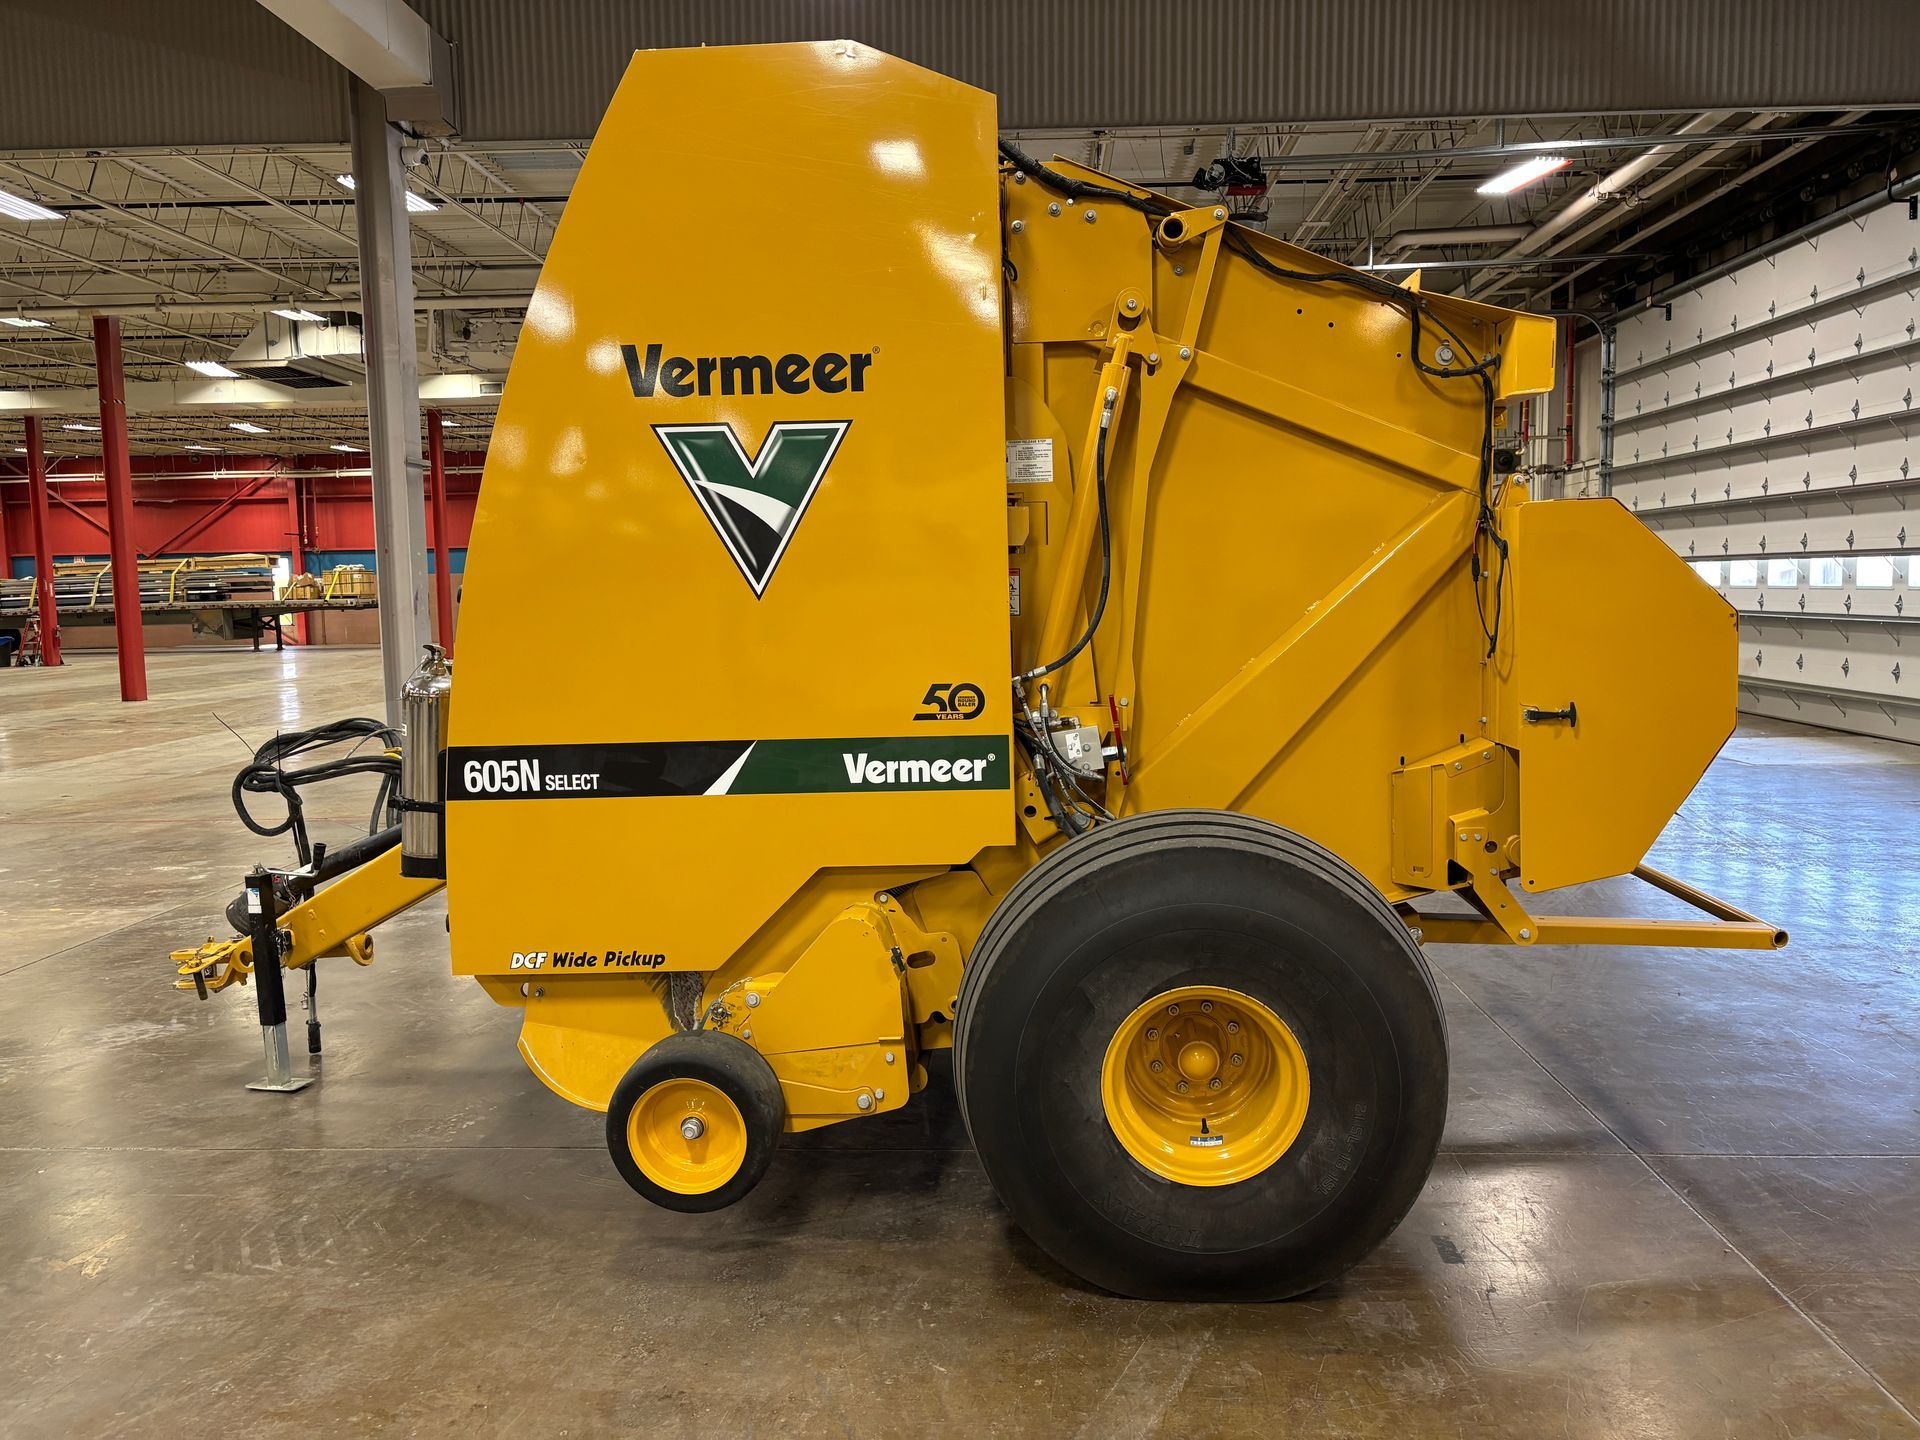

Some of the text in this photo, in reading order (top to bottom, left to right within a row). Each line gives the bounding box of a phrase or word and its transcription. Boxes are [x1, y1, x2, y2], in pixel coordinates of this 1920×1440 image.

[463, 759, 600, 793] 605N SELECT
[510, 950, 666, 969] DCF Wide Pickup
